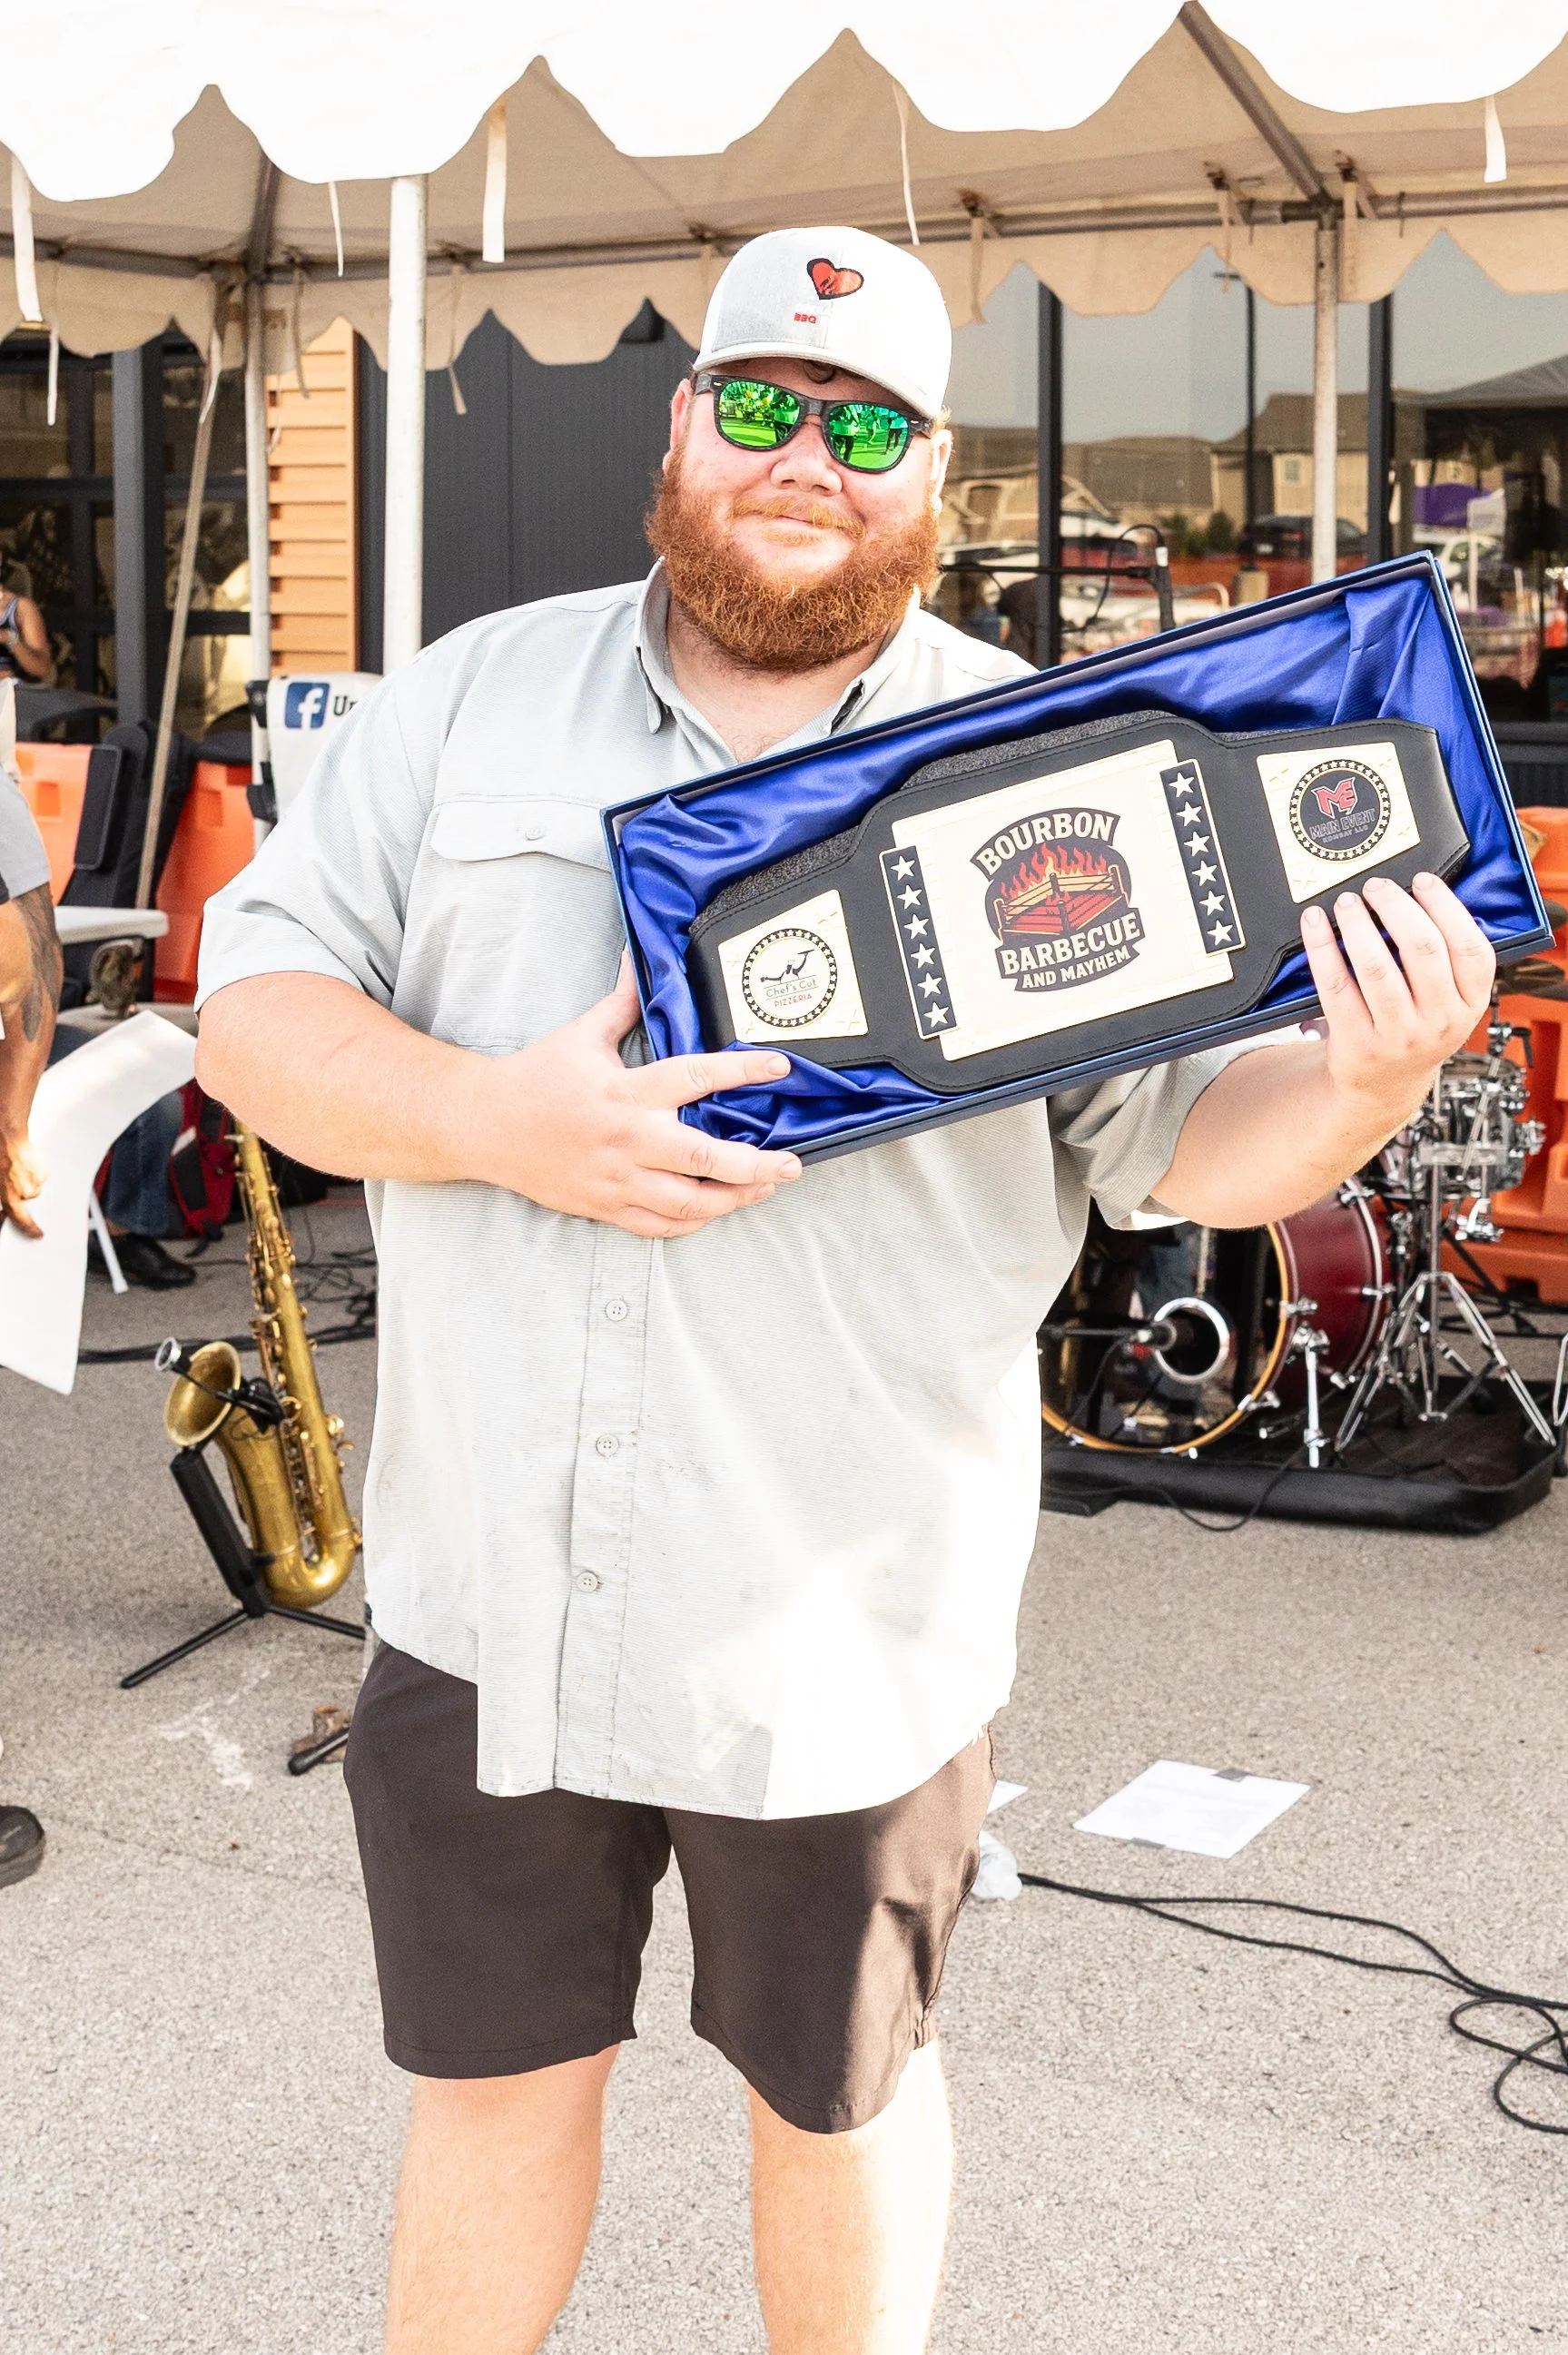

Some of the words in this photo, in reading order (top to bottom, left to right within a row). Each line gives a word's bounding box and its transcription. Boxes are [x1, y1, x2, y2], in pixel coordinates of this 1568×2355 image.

[794, 312, 817, 324] BBQ
[1308, 819, 1341, 840] MAIN
[1339, 807, 1376, 831] EVENT
[1354, 824, 1369, 834] LLC
[976, 812, 1115, 876] BOURBON
[1000, 912, 1140, 975] BARBECUE
[1022, 971, 1057, 989] AND
[1060, 945, 1131, 982] MAYHEM
[765, 983, 797, 998] Chef's
[798, 978, 817, 989] Cut
[774, 993, 813, 1007] PIZZERIA
